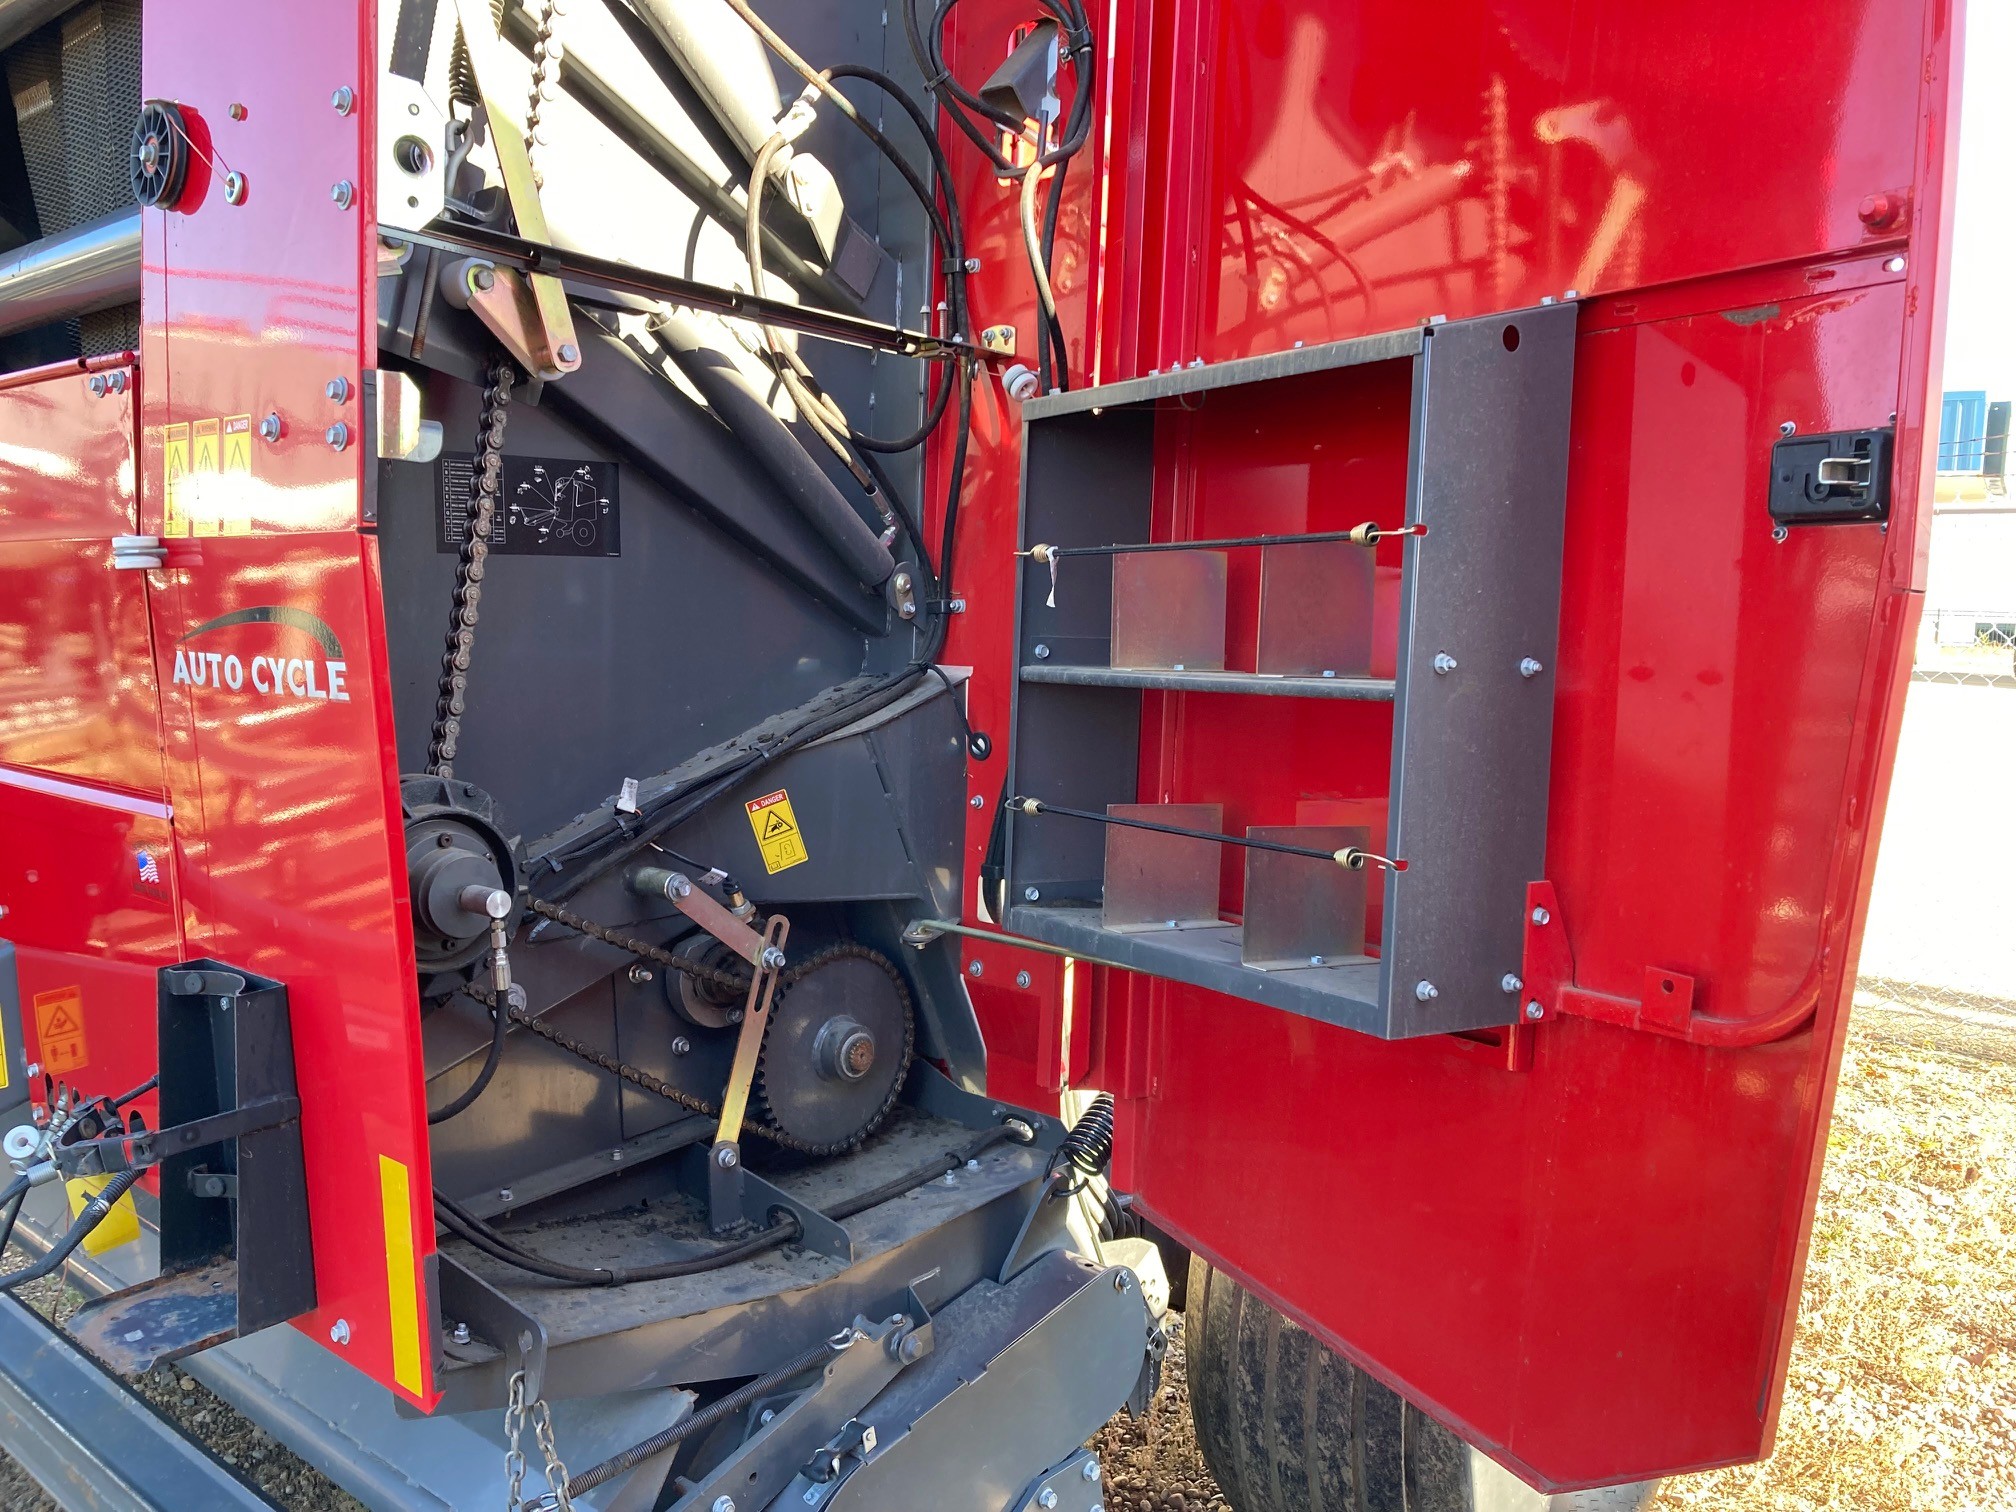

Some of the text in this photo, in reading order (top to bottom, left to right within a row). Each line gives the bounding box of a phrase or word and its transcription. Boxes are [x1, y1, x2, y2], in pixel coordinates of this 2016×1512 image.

[172, 650, 350, 701] AUTO CYCLE
[761, 794, 784, 807] DANGER
